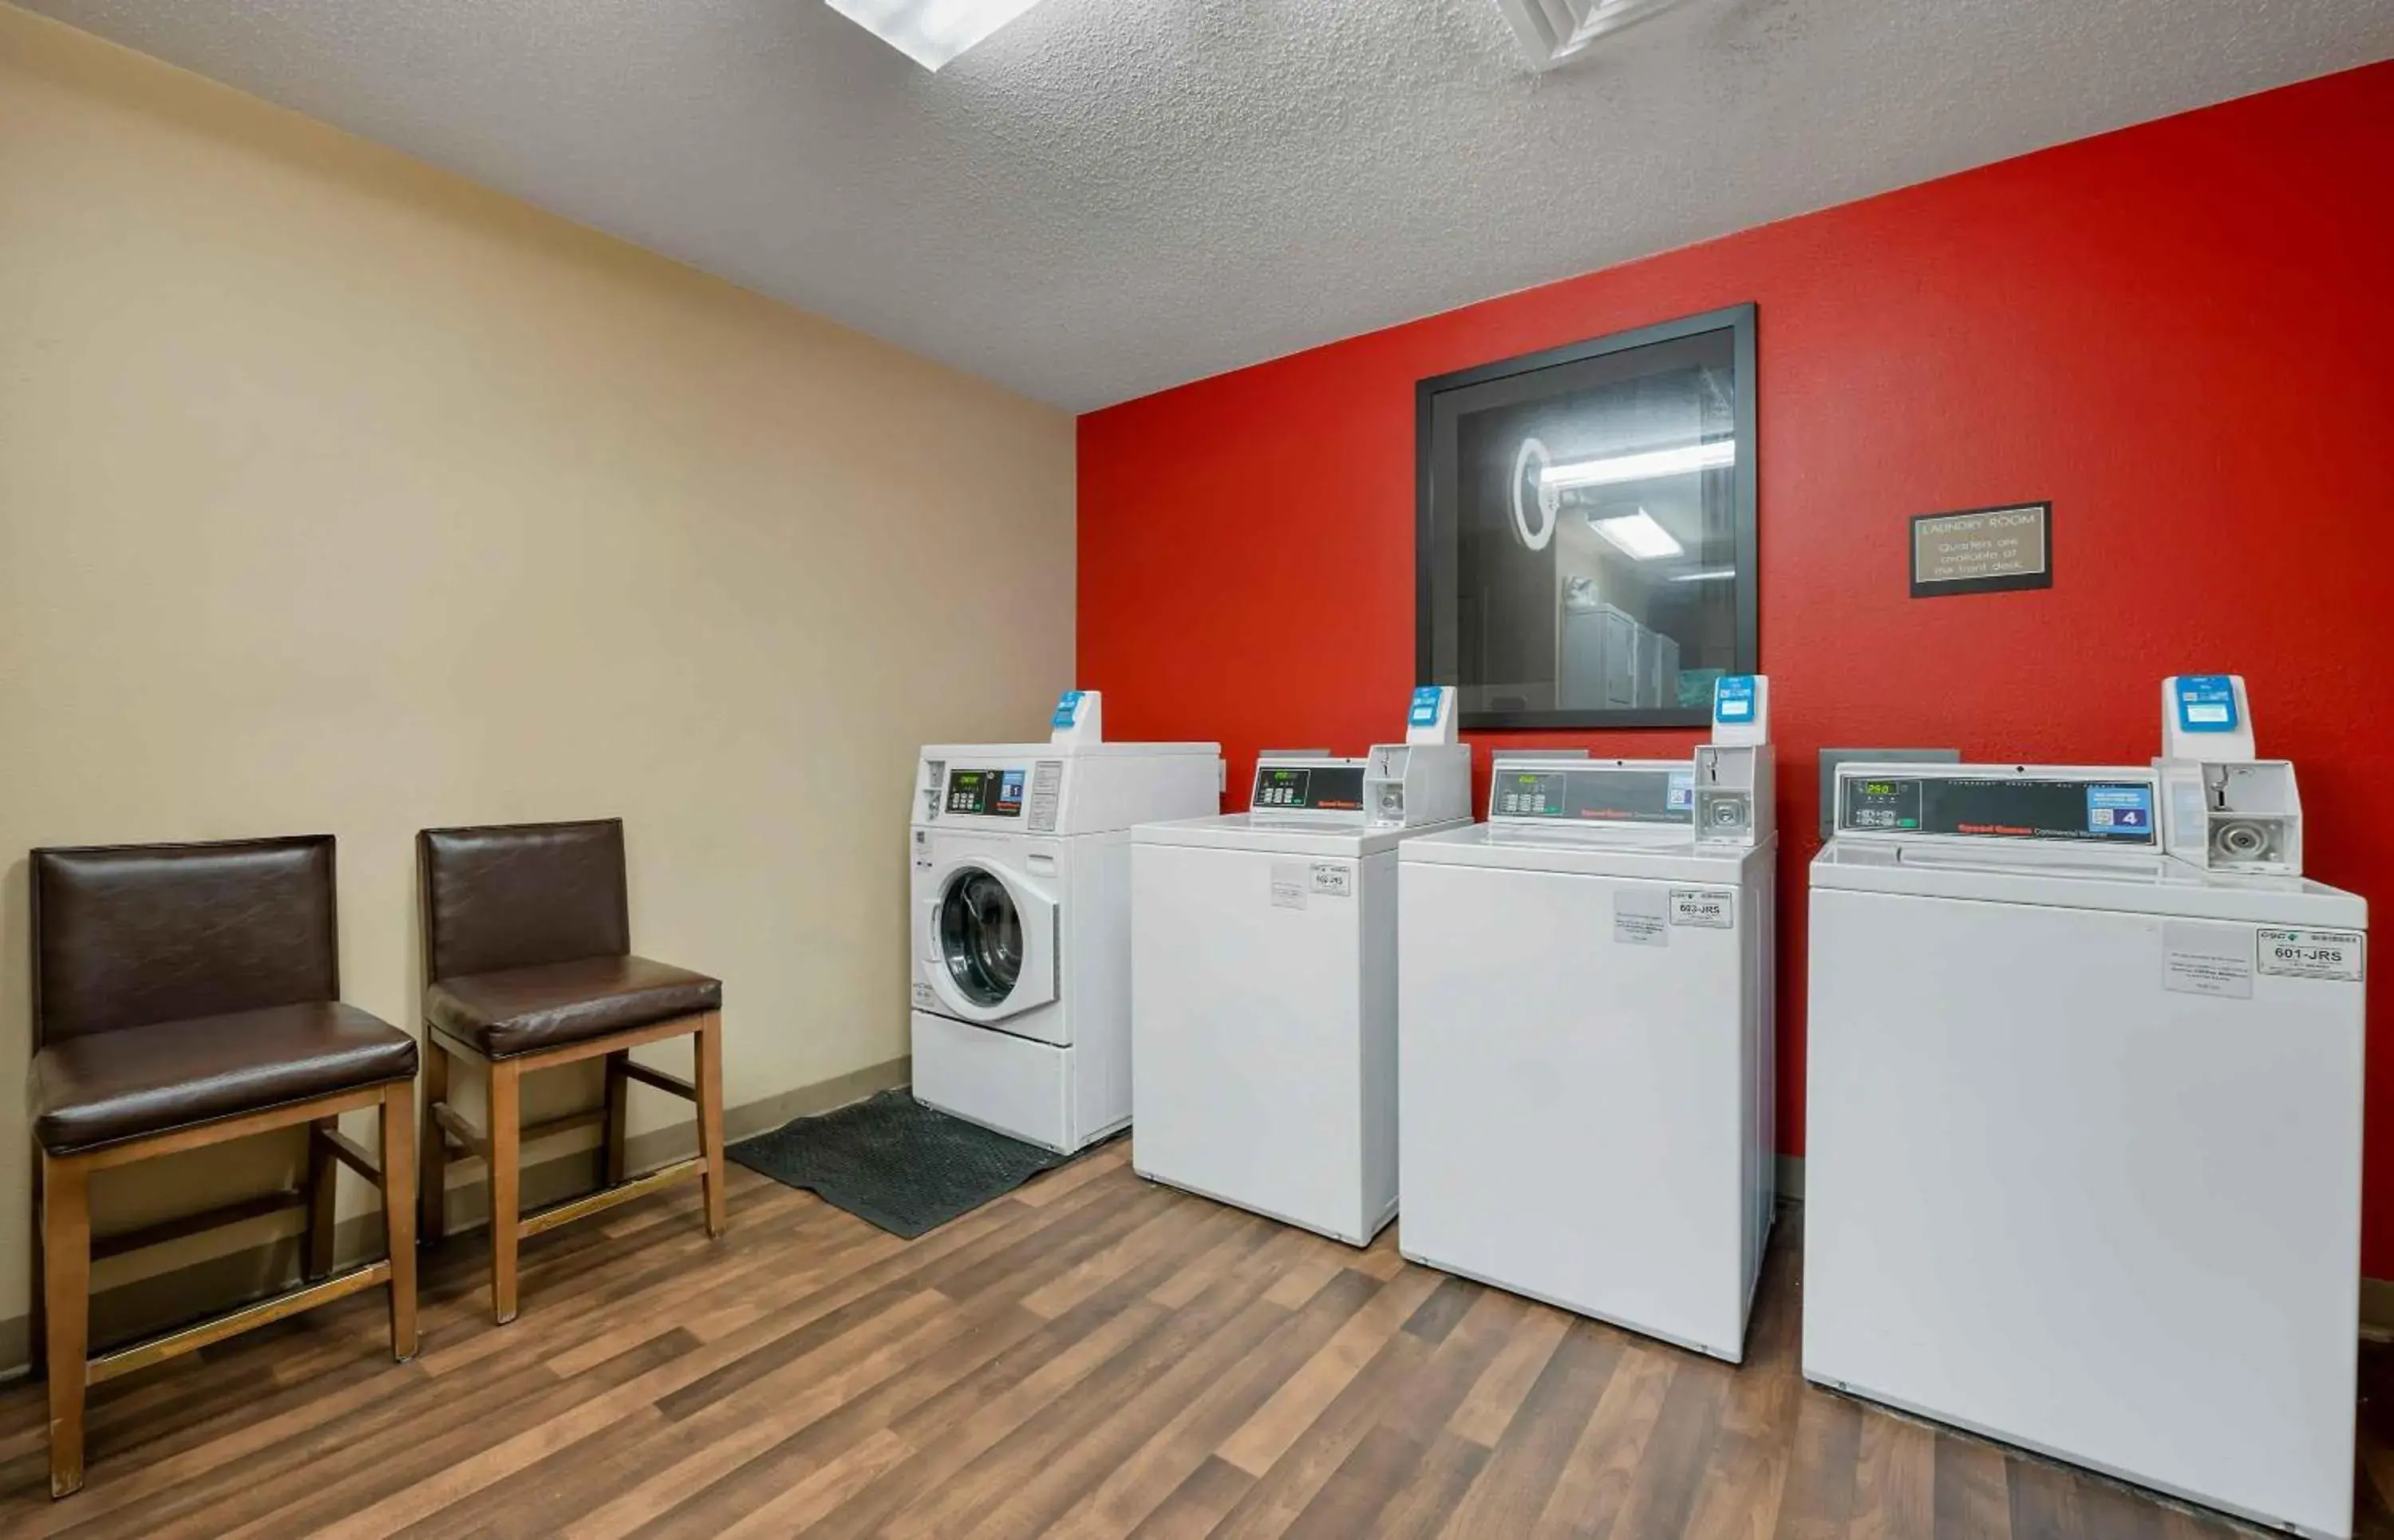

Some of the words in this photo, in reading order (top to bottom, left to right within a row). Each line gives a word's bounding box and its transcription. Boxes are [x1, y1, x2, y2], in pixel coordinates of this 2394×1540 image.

[1922, 520, 1982, 535] LAUNDRY
[1989, 515, 2035, 527] ROOM
[1938, 541, 1992, 552] Quarters
[2123, 811, 2137, 824] 4
[2274, 946, 2343, 962] 601-JRS
